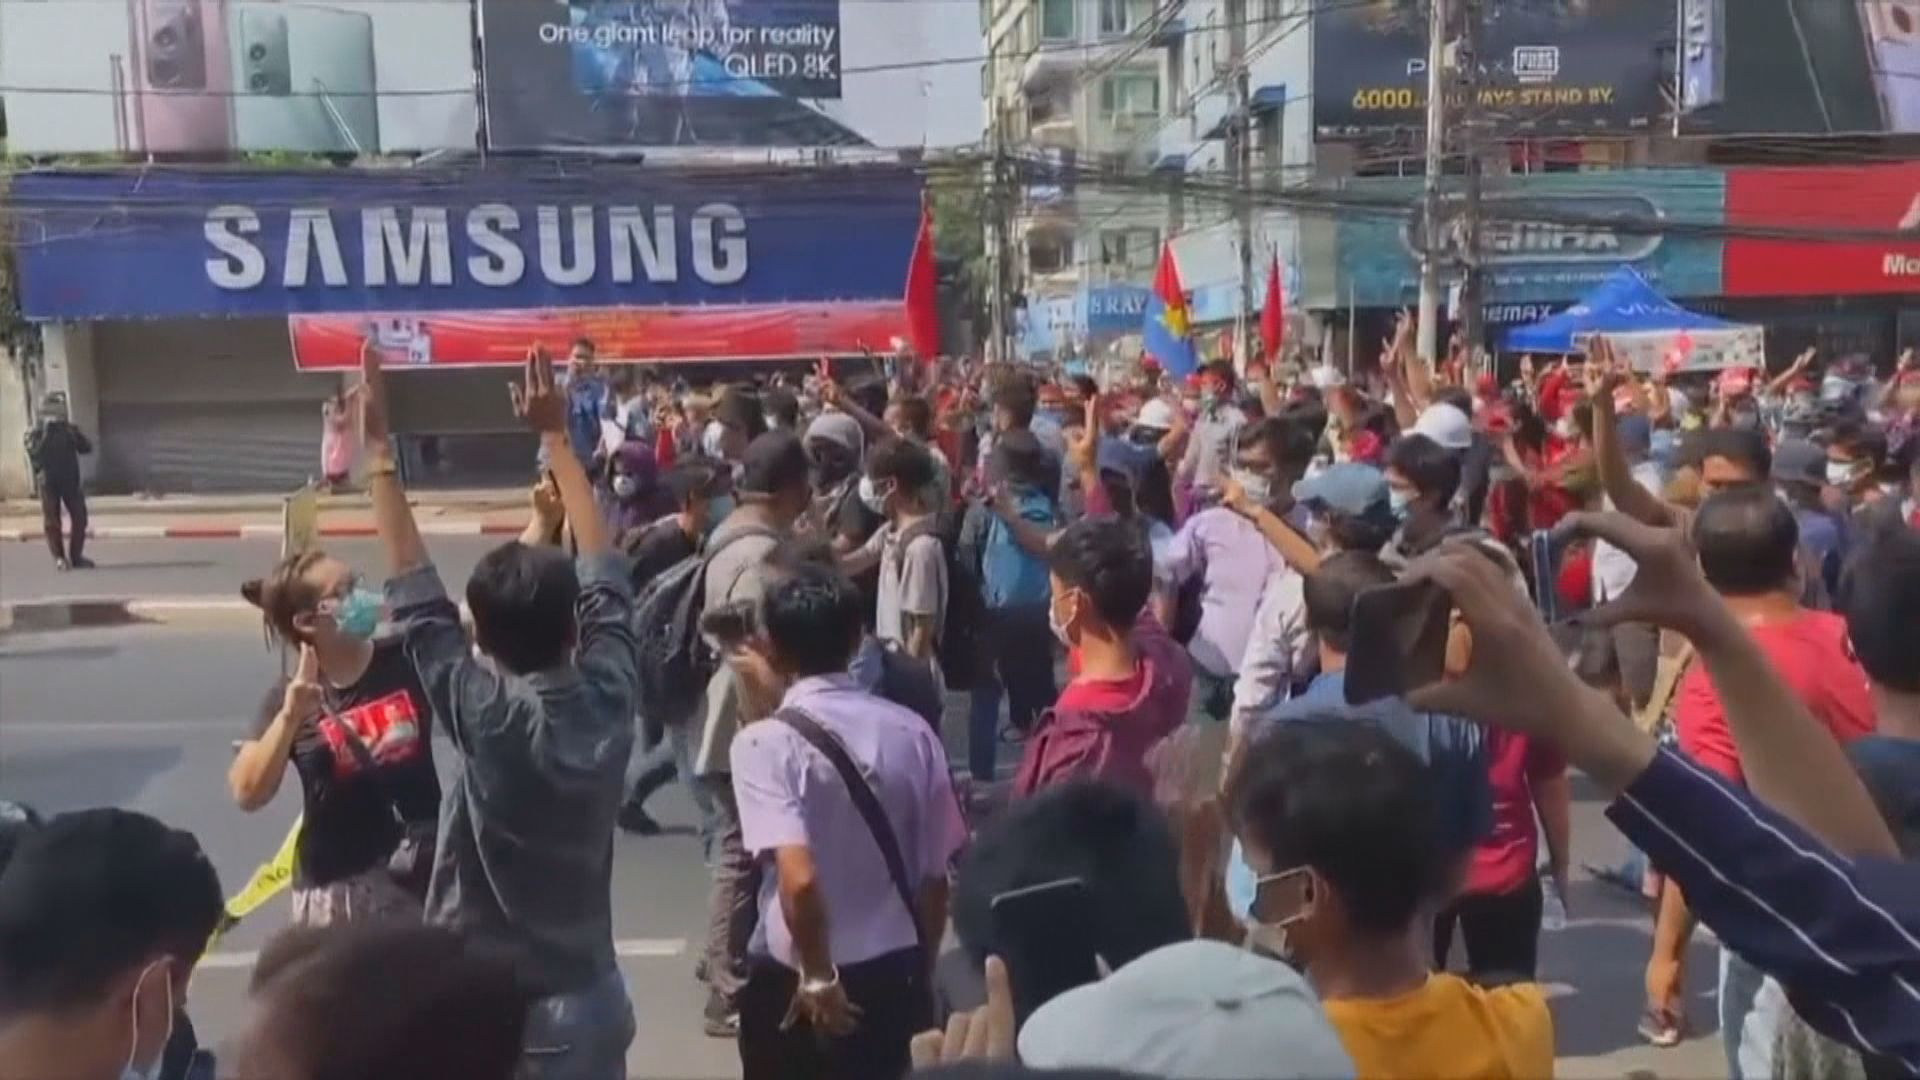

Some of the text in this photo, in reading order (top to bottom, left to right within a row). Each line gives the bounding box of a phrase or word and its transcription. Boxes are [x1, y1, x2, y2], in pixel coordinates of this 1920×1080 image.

[539, 23, 588, 44] One
[594, 22, 655, 47] giant
[722, 24, 753, 44] for
[760, 23, 835, 47] reality
[724, 53, 836, 79] QLED 8K
[1353, 89, 1412, 109] 6000
[1519, 87, 1583, 106] STAND
[1588, 87, 1615, 105] BY.
[203, 204, 749, 290] SAMSUNG
